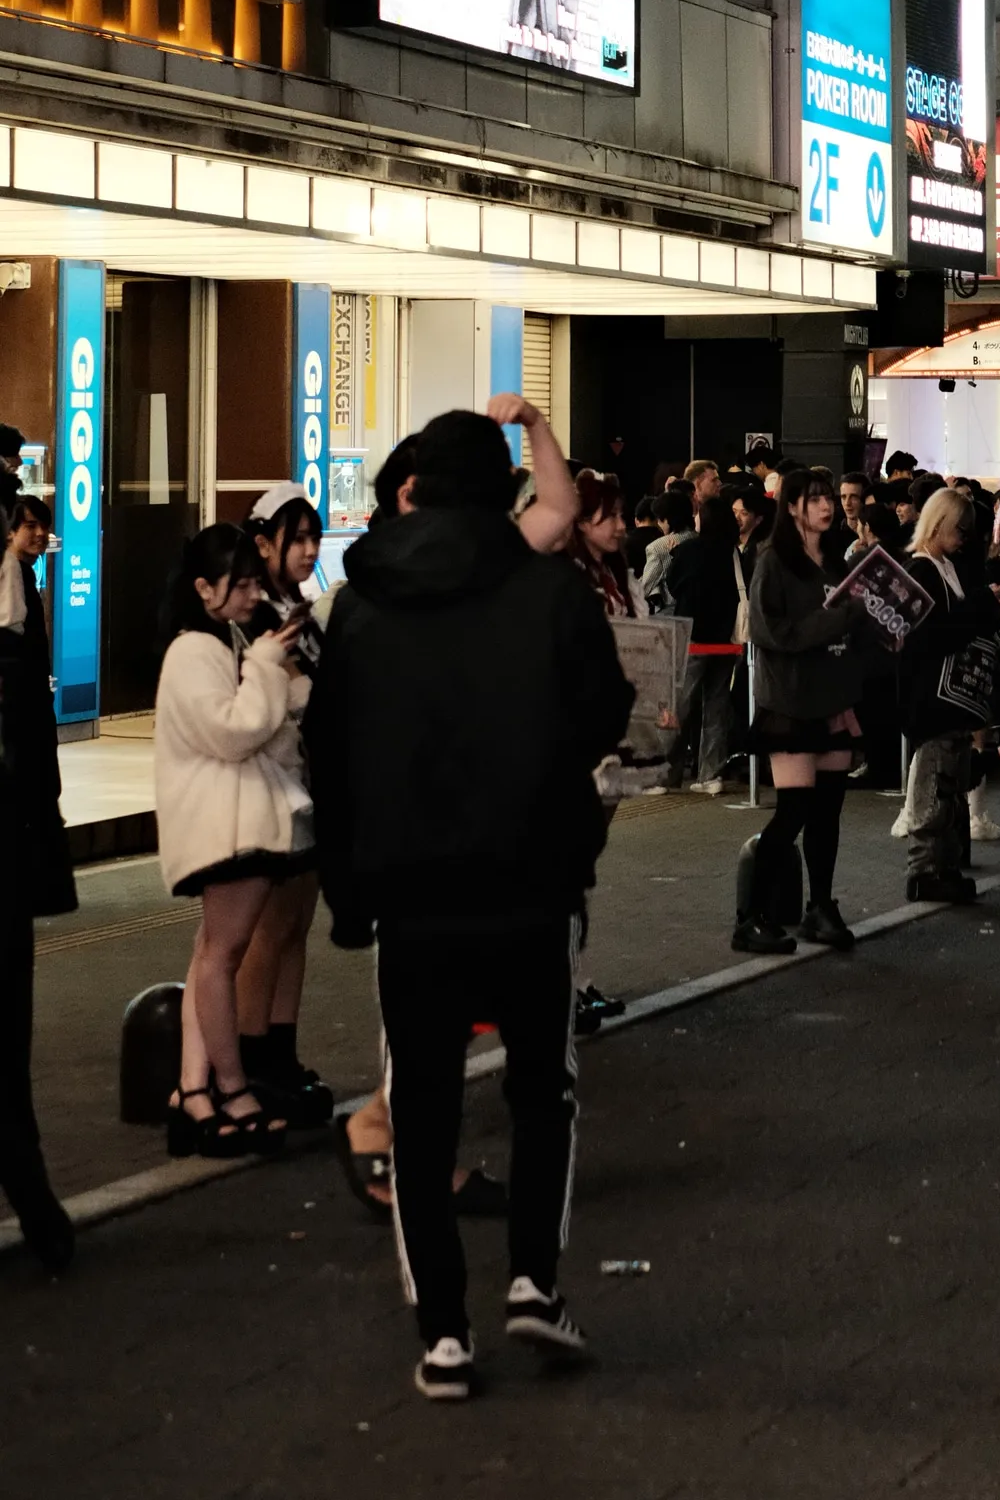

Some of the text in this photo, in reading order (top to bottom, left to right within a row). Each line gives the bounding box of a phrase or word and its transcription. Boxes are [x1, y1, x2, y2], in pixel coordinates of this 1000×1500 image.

[806, 67, 888, 129] POKER ROOM
[906, 66, 947, 123] STAGE
[809, 137, 840, 226] 2F
[335, 294, 351, 425] EXCHANGE
[848, 416, 866, 429] WARP
